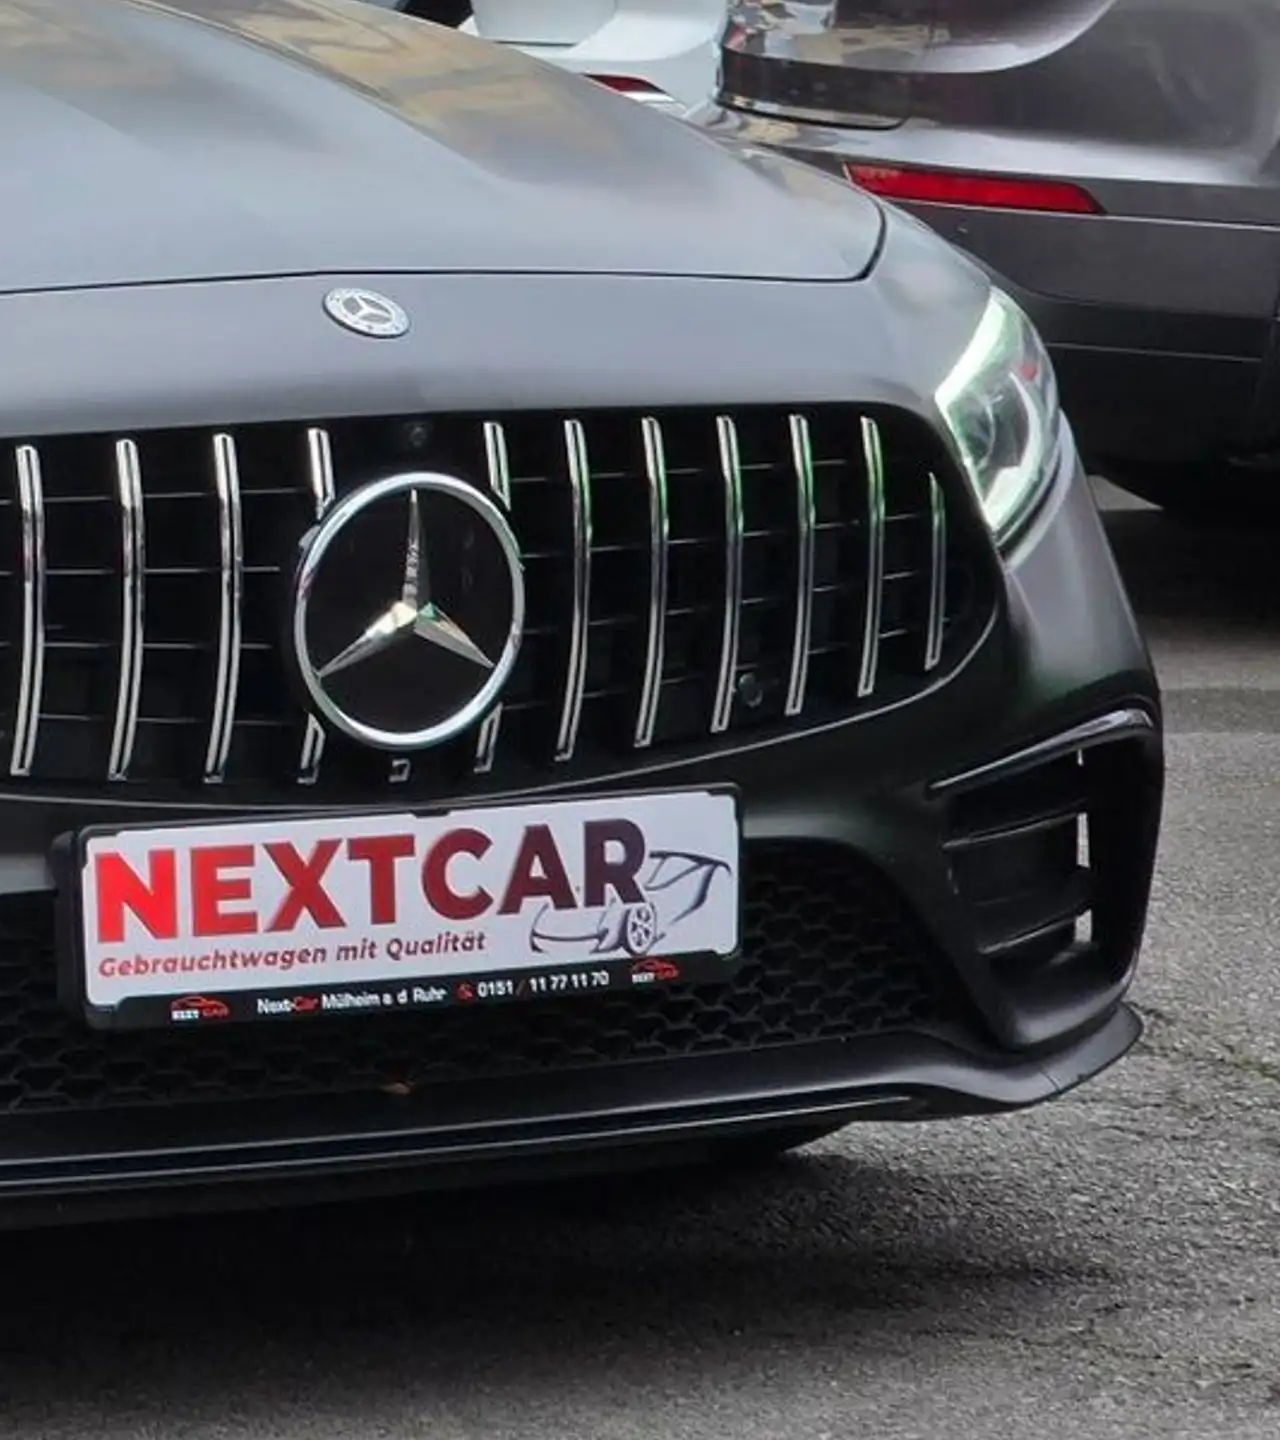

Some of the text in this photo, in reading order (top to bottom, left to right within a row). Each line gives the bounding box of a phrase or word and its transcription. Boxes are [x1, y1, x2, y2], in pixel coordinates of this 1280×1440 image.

[95, 817, 646, 942] NEXTCAR
[98, 931, 487, 979] Gebrauchtwagen mit Qualität
